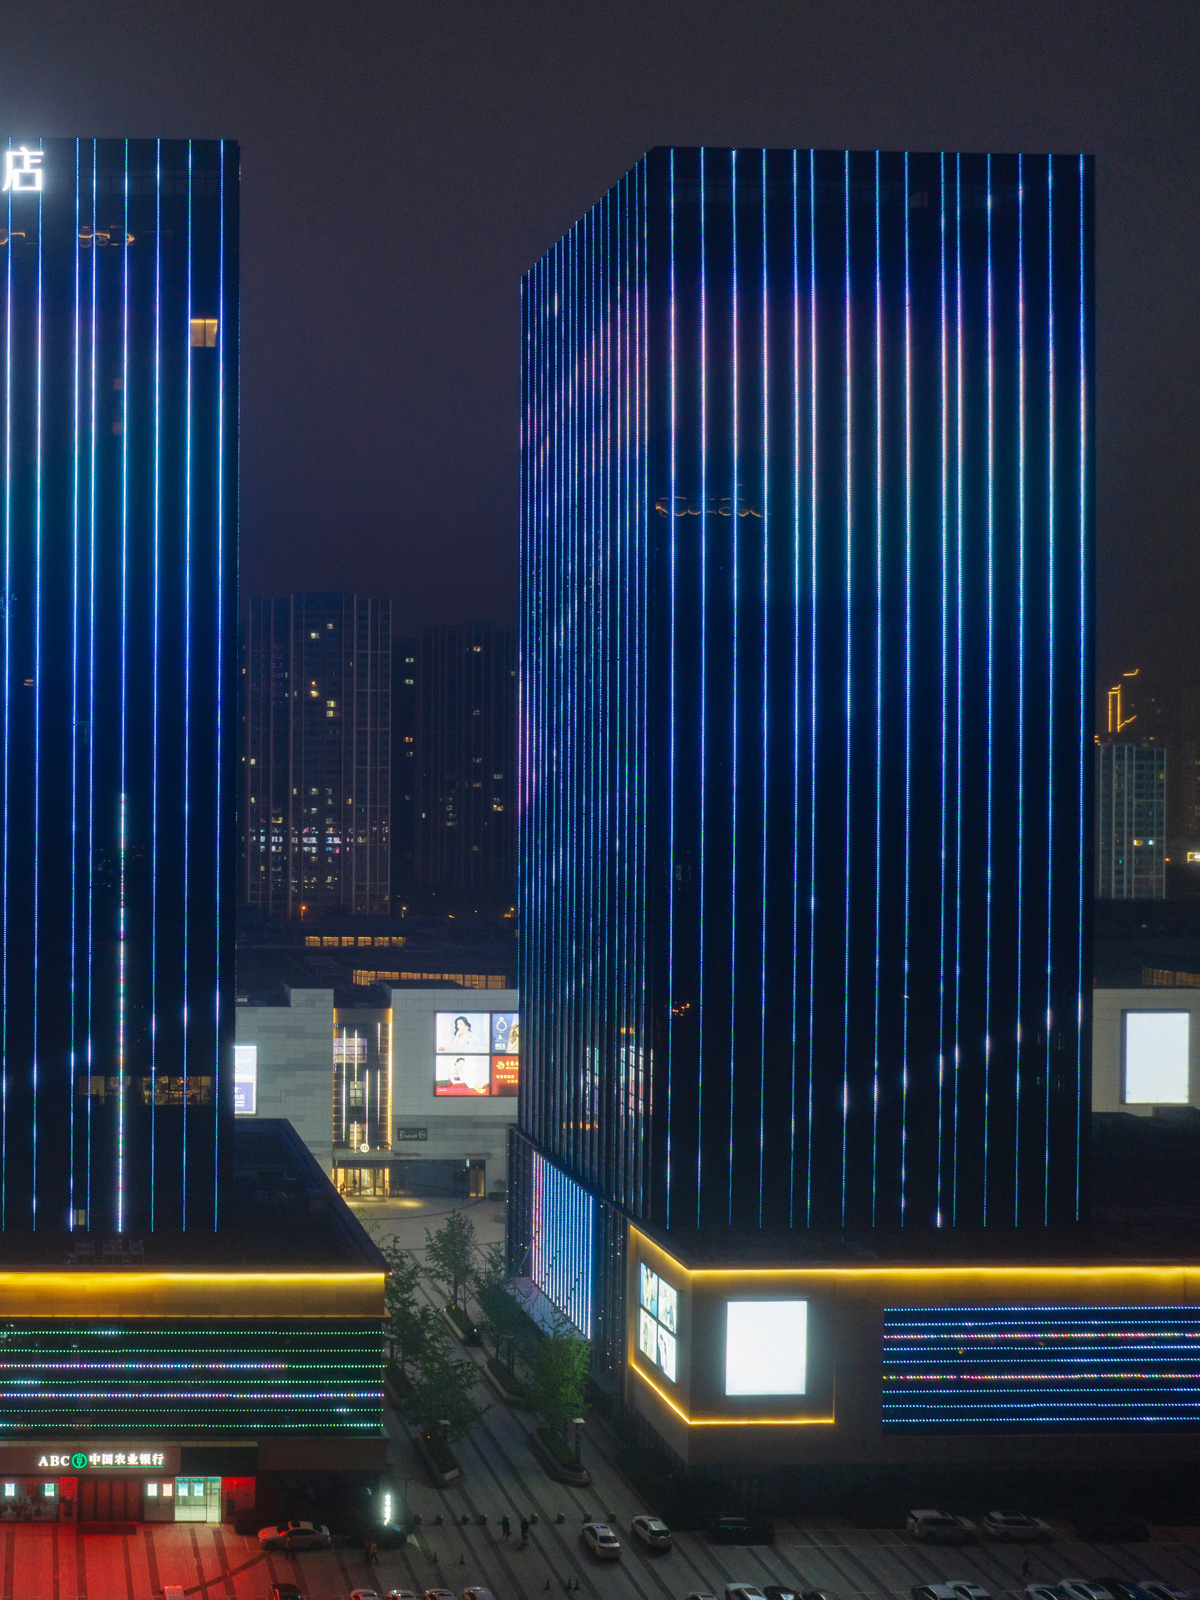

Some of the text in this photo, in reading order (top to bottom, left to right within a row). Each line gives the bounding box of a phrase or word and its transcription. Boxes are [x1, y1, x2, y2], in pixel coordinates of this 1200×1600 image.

[38, 1453, 164, 1467] ABC 中国农业银行
